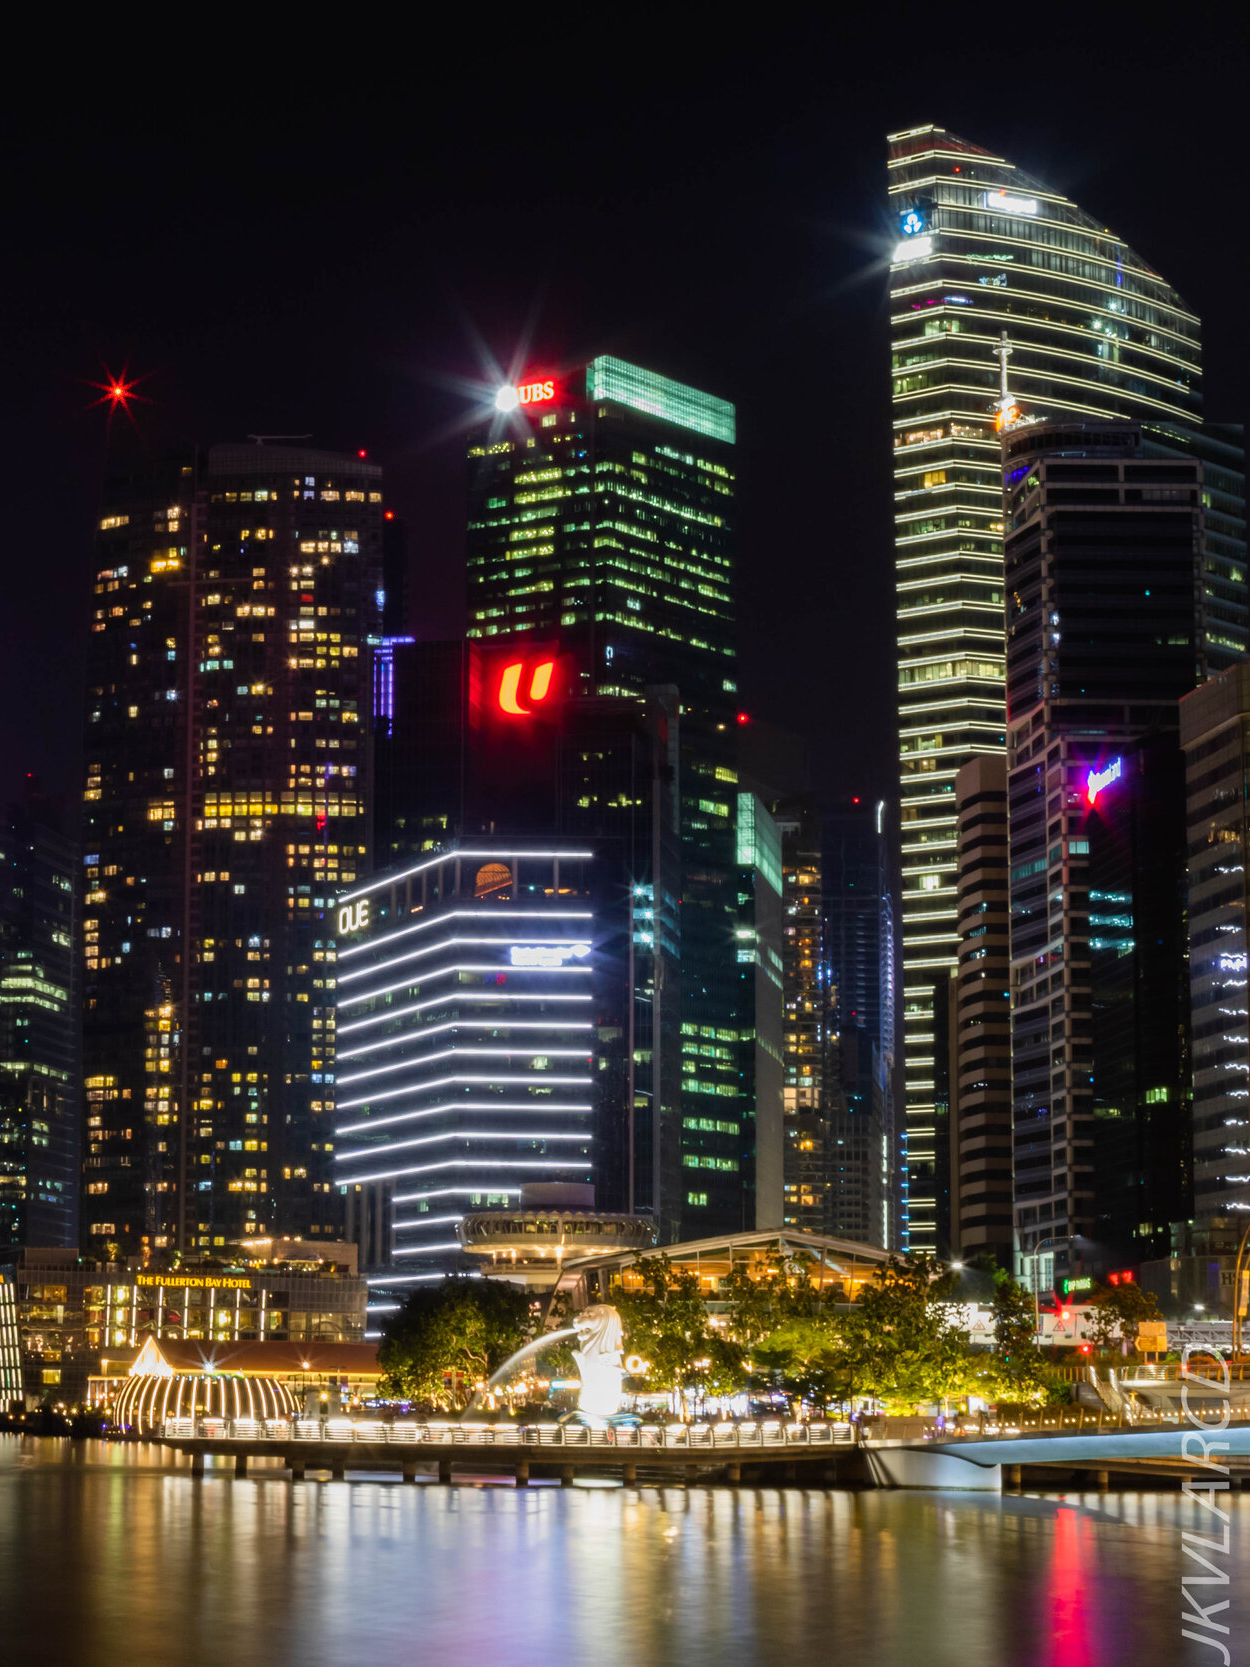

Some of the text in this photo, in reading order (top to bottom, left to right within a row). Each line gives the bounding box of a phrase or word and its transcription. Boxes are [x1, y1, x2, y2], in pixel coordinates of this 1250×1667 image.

[518, 380, 555, 404] UBS
[339, 899, 369, 935] OUE
[136, 1275, 251, 1289] THE FULLERTON BAY HOTEL
